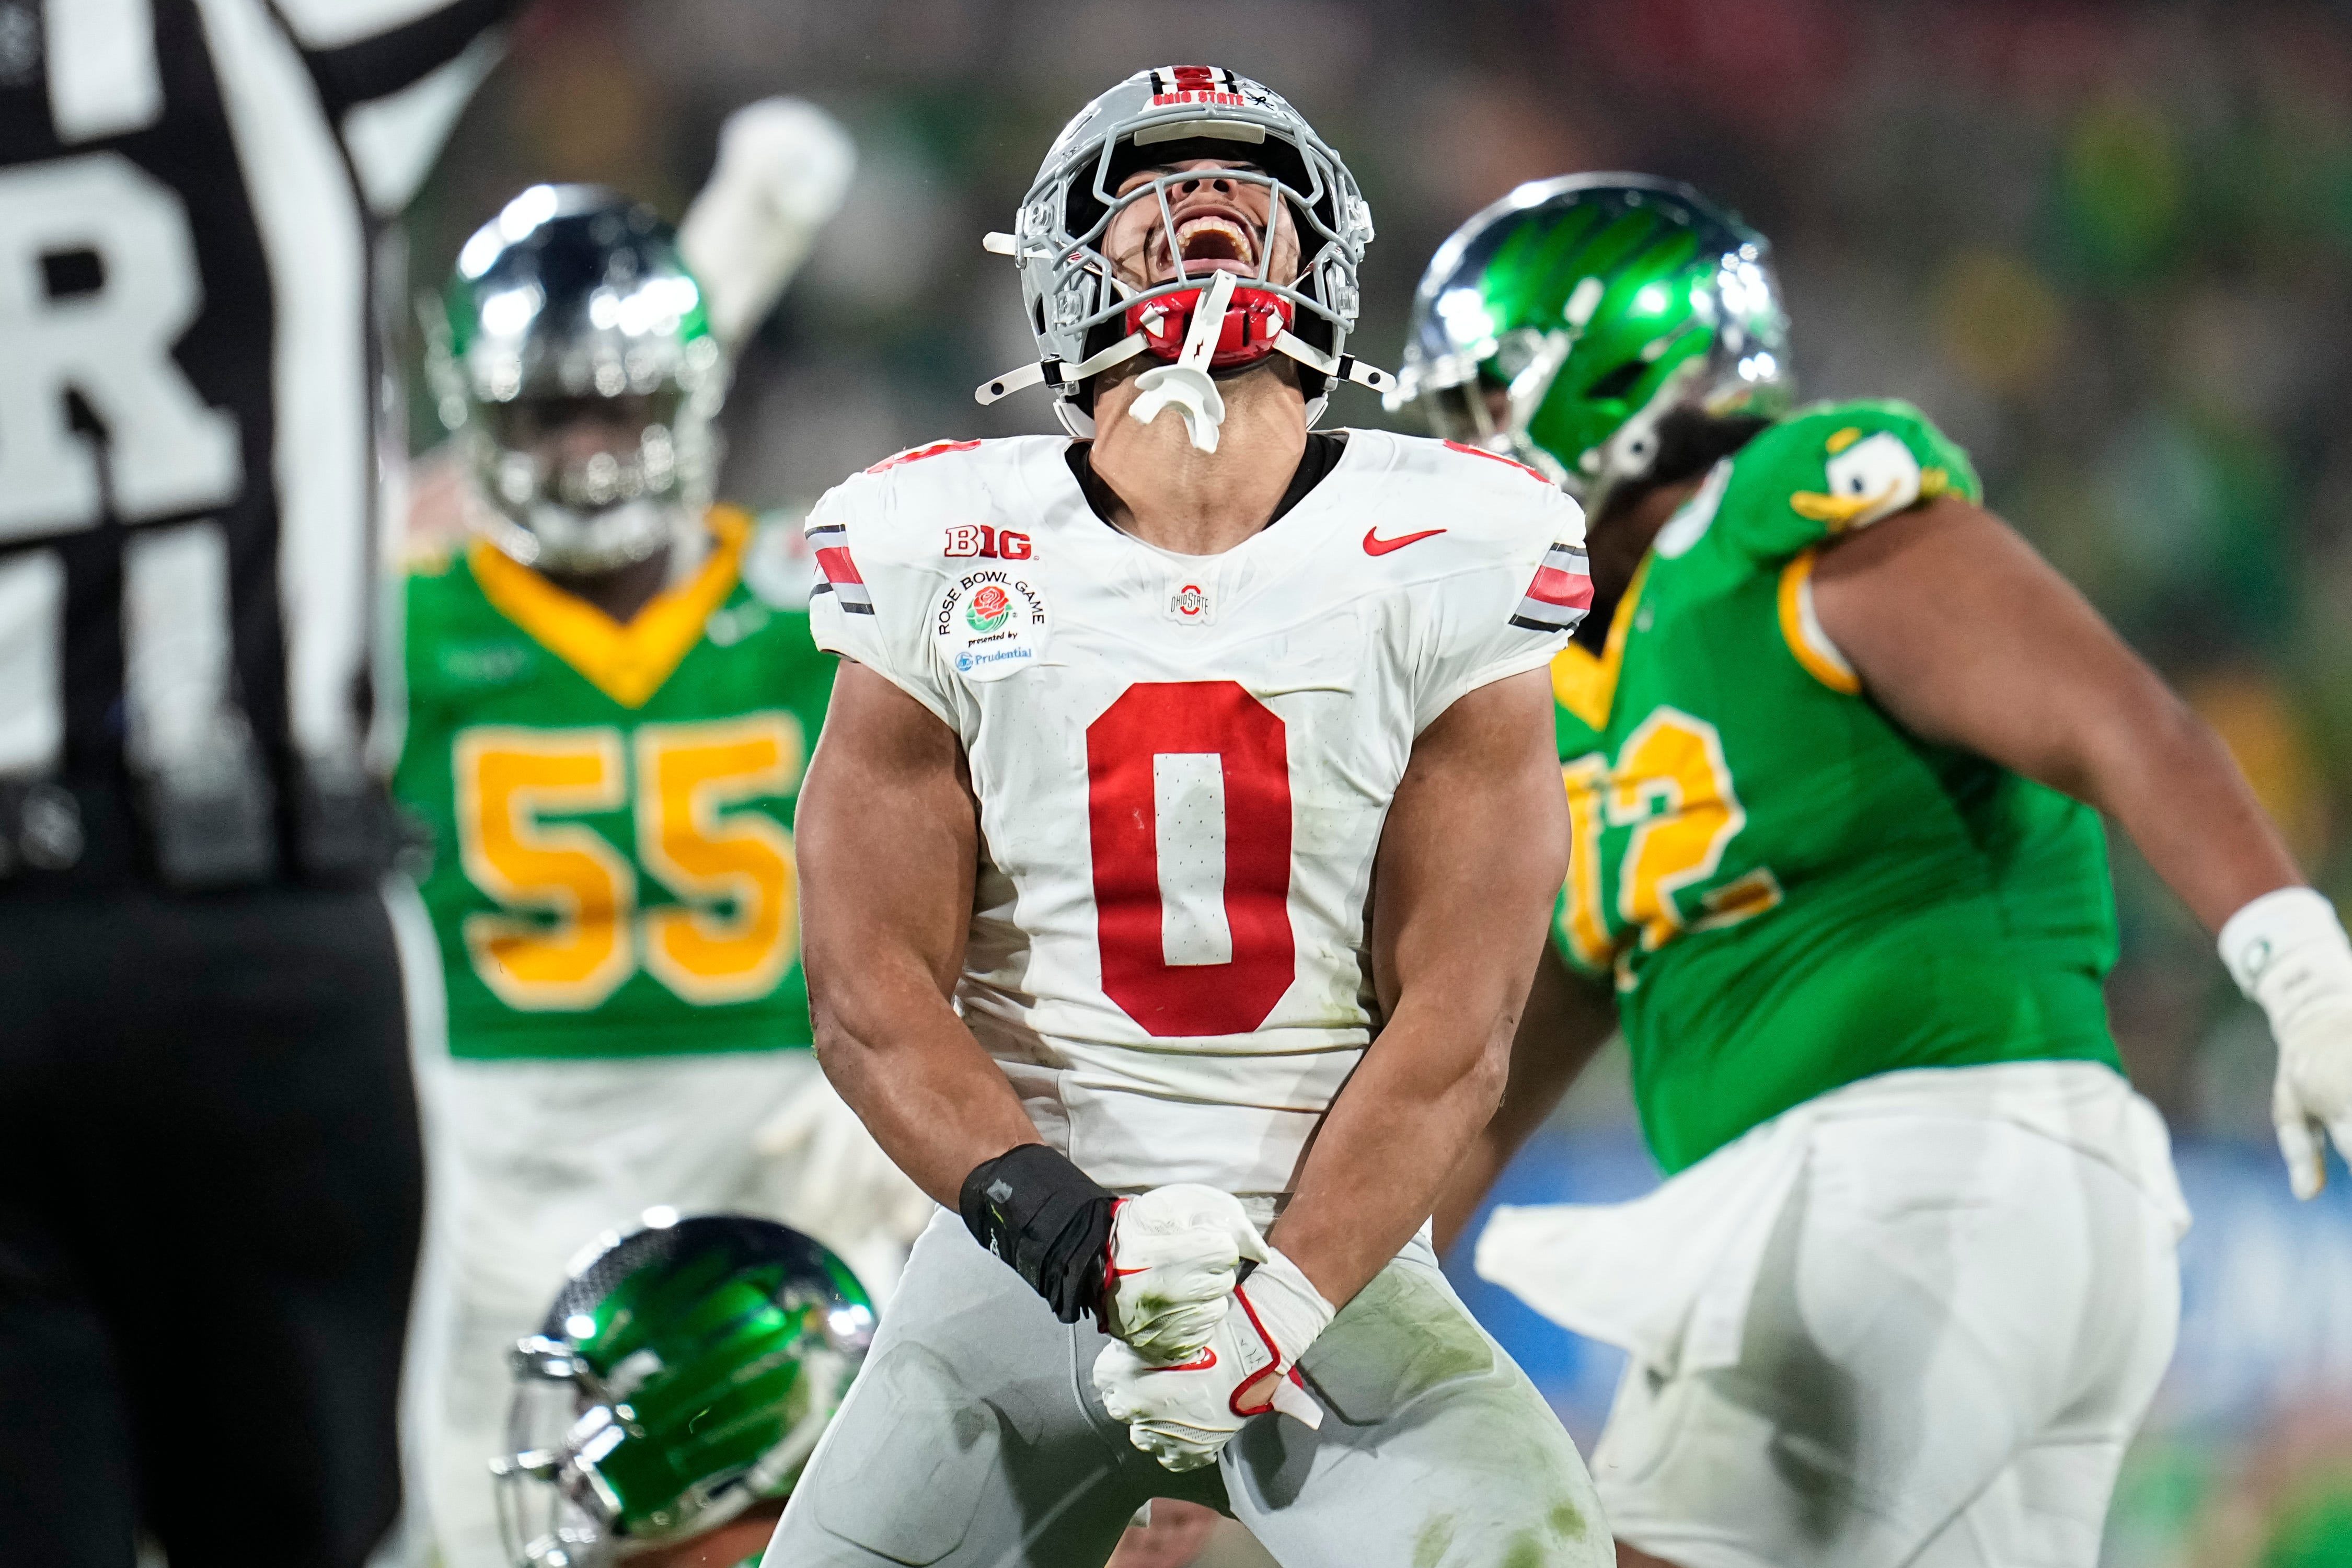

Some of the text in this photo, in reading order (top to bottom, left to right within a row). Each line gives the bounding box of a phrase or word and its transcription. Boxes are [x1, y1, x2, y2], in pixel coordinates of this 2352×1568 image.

[1154, 90, 1244, 106] OHIO STATE
[0, 149, 244, 538] R
[939, 571, 1044, 636] ROSE BOWL GAME
[968, 631, 1018, 648] presented by
[975, 647, 1032, 665] Prudential
[452, 708, 806, 1011] 55
[1086, 681, 1296, 1037] 0
